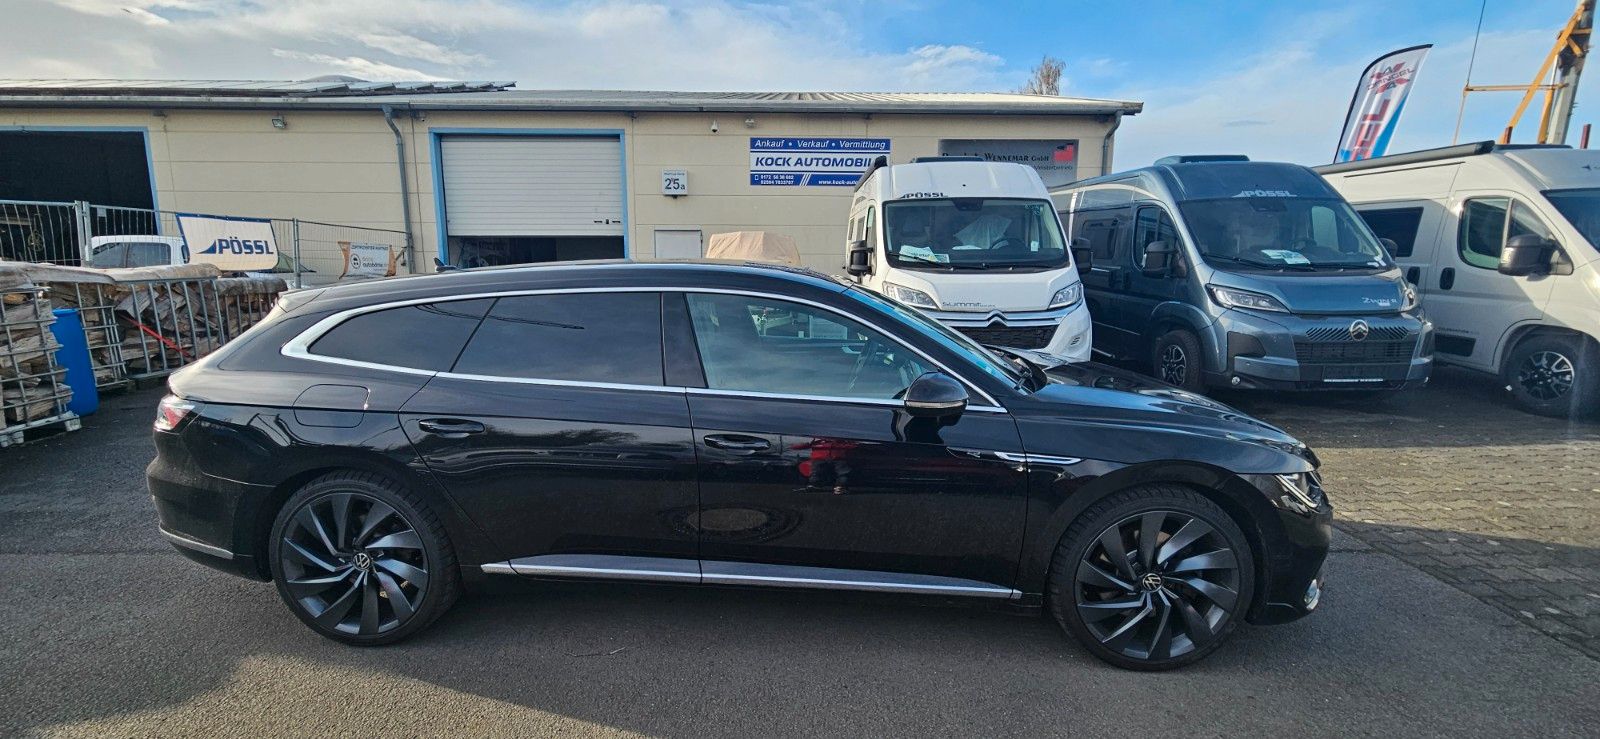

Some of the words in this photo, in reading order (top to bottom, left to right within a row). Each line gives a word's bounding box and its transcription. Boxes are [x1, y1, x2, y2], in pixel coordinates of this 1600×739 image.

[754, 140, 784, 148] Ankauf
[797, 140, 829, 148] Verkauf
[839, 140, 886, 150] Vermittlung
[755, 157, 791, 167] KOCK
[793, 157, 873, 167] AUTOMOBIL
[664, 177, 686, 190] 25a
[217, 236, 274, 255] PÖSSL
